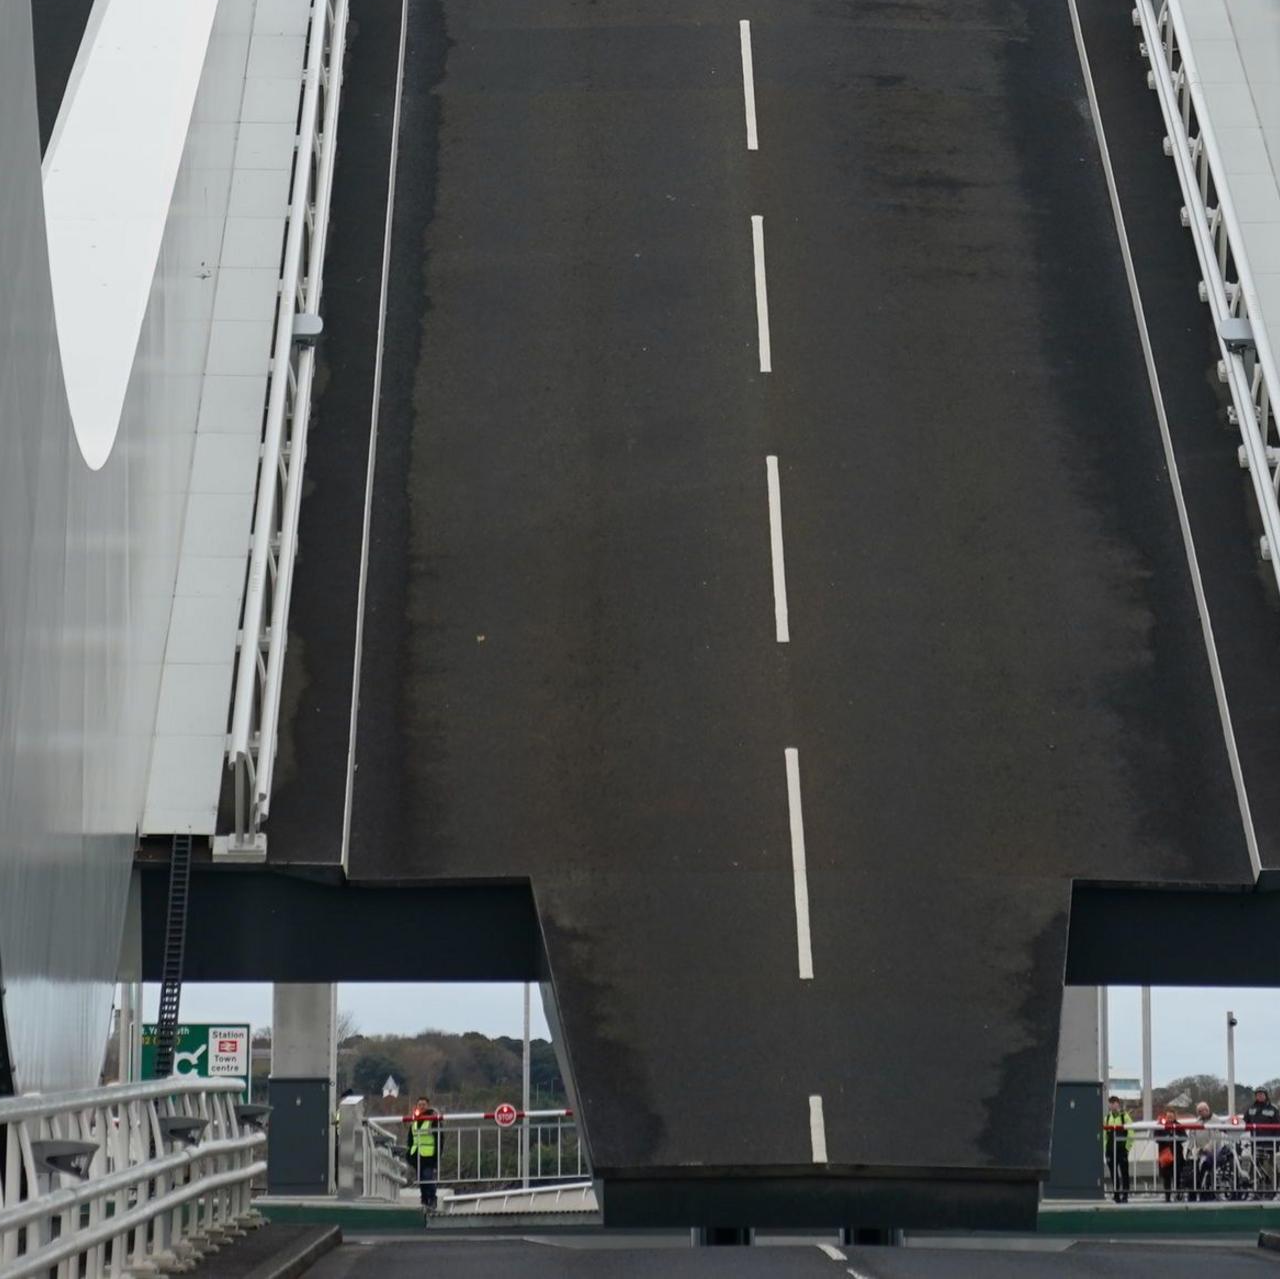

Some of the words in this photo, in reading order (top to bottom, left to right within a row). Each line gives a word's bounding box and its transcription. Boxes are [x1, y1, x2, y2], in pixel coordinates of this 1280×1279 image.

[212, 1031, 244, 1039] Station
[211, 1064, 239, 1072] centre
[498, 1113, 513, 1121] STOP
